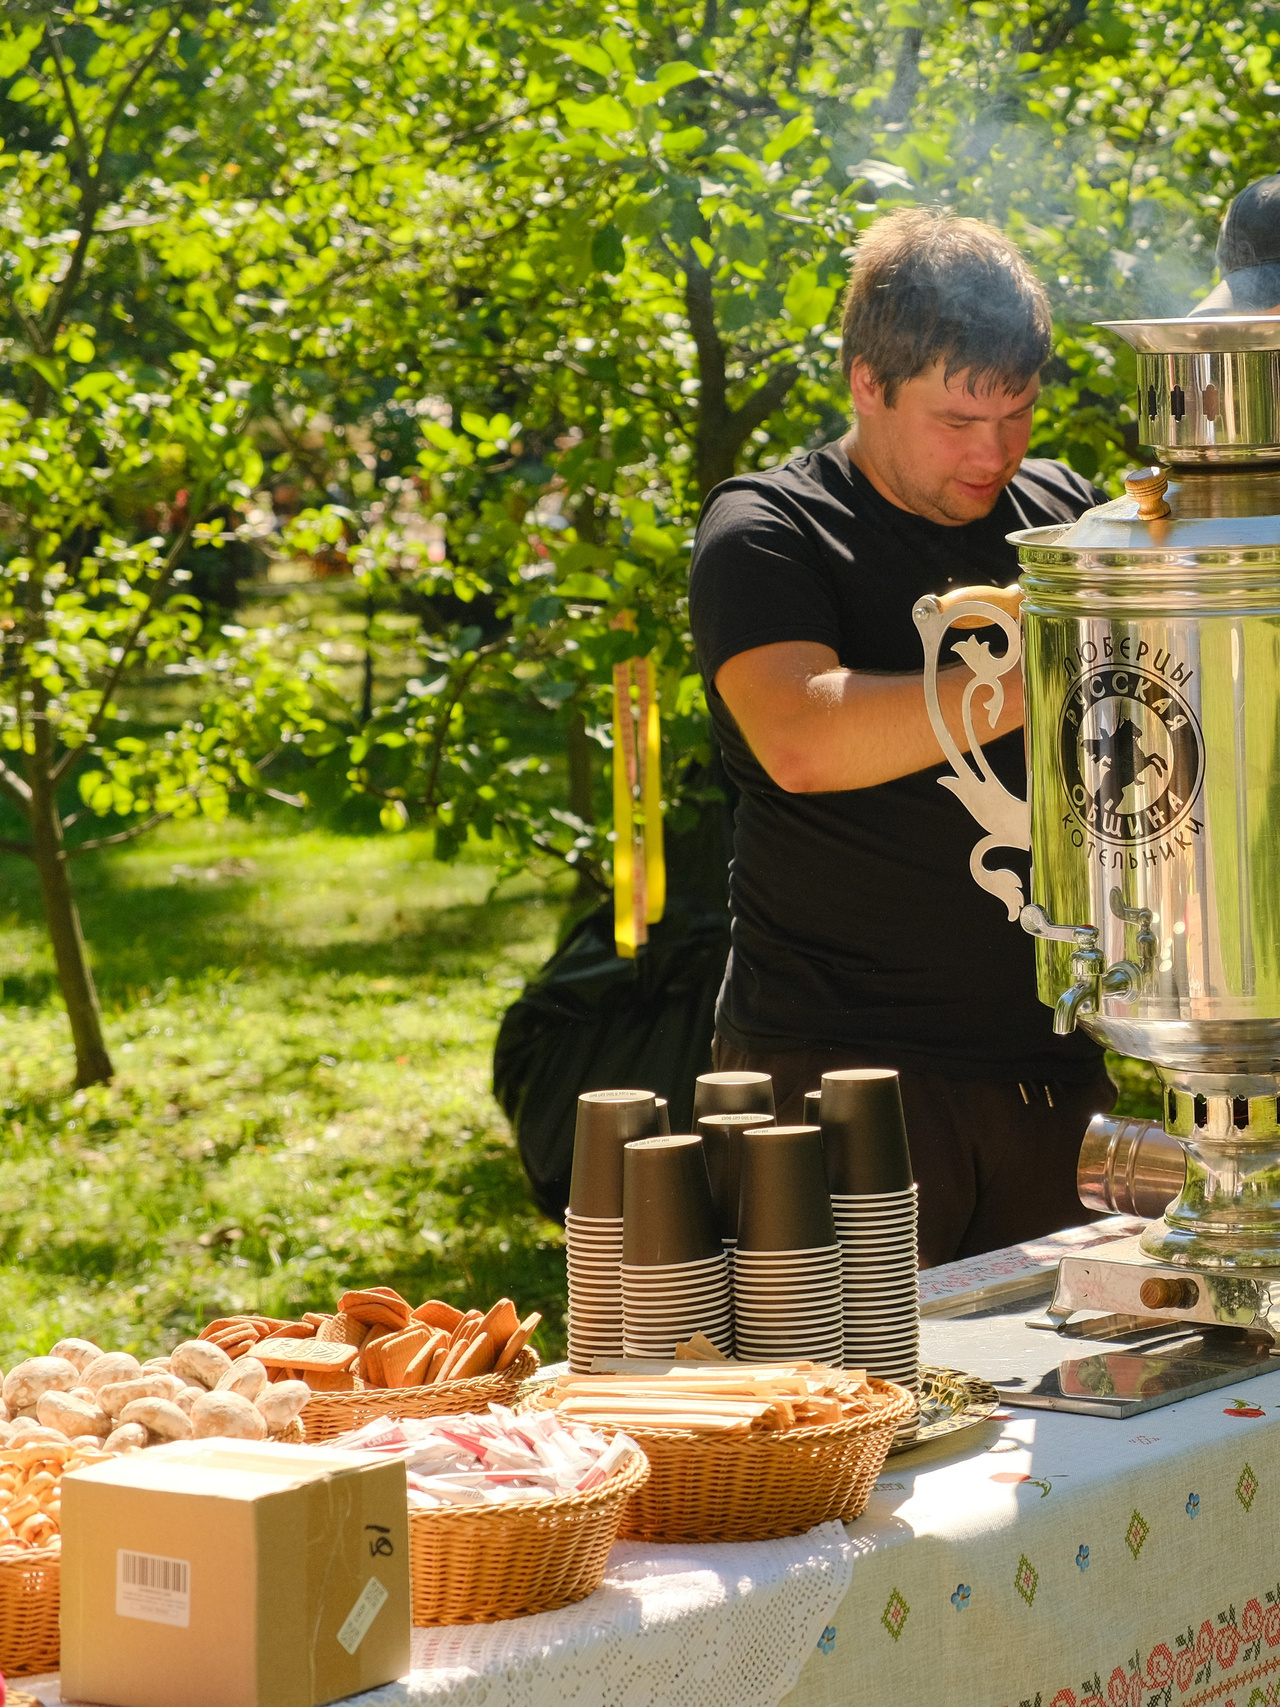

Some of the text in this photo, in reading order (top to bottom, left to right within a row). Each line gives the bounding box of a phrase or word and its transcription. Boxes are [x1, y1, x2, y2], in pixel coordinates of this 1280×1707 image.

[1063, 637, 1193, 687] ЛЮБЕРЦЫ
[1066, 671, 1188, 732] РУССКАЯ
[1072, 784, 1183, 837] ОБЩИНА
[1062, 813, 1204, 870] КОТЕЛЬНИКИ
[366, 1432, 394, 1448] САХАР
